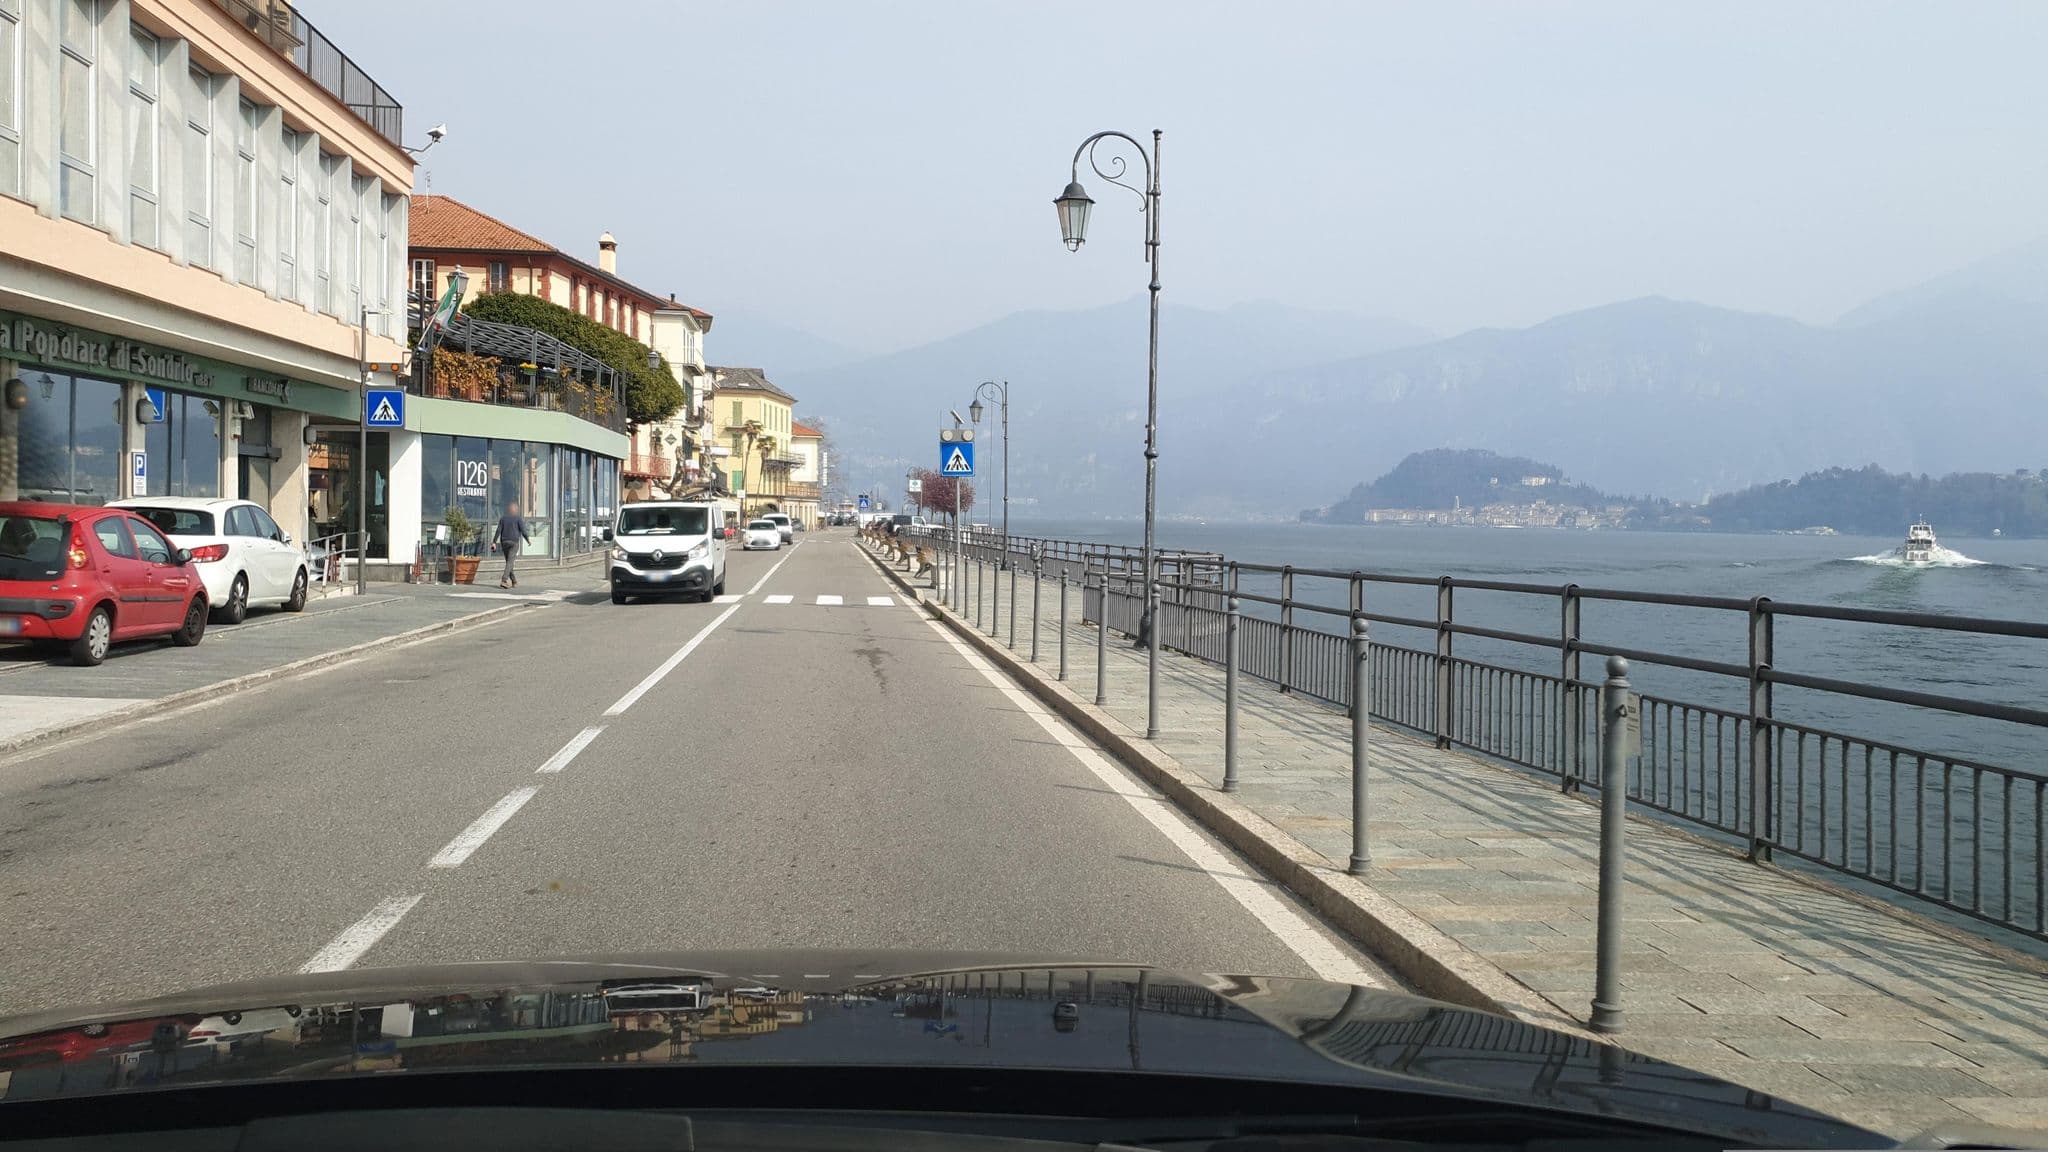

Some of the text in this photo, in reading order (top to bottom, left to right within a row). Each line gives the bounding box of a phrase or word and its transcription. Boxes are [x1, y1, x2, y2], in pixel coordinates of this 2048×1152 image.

[18, 320, 108, 367] Popolare
[116, 341, 130, 371] di
[138, 347, 194, 383] Sondrio
[136, 456, 144, 475] P
